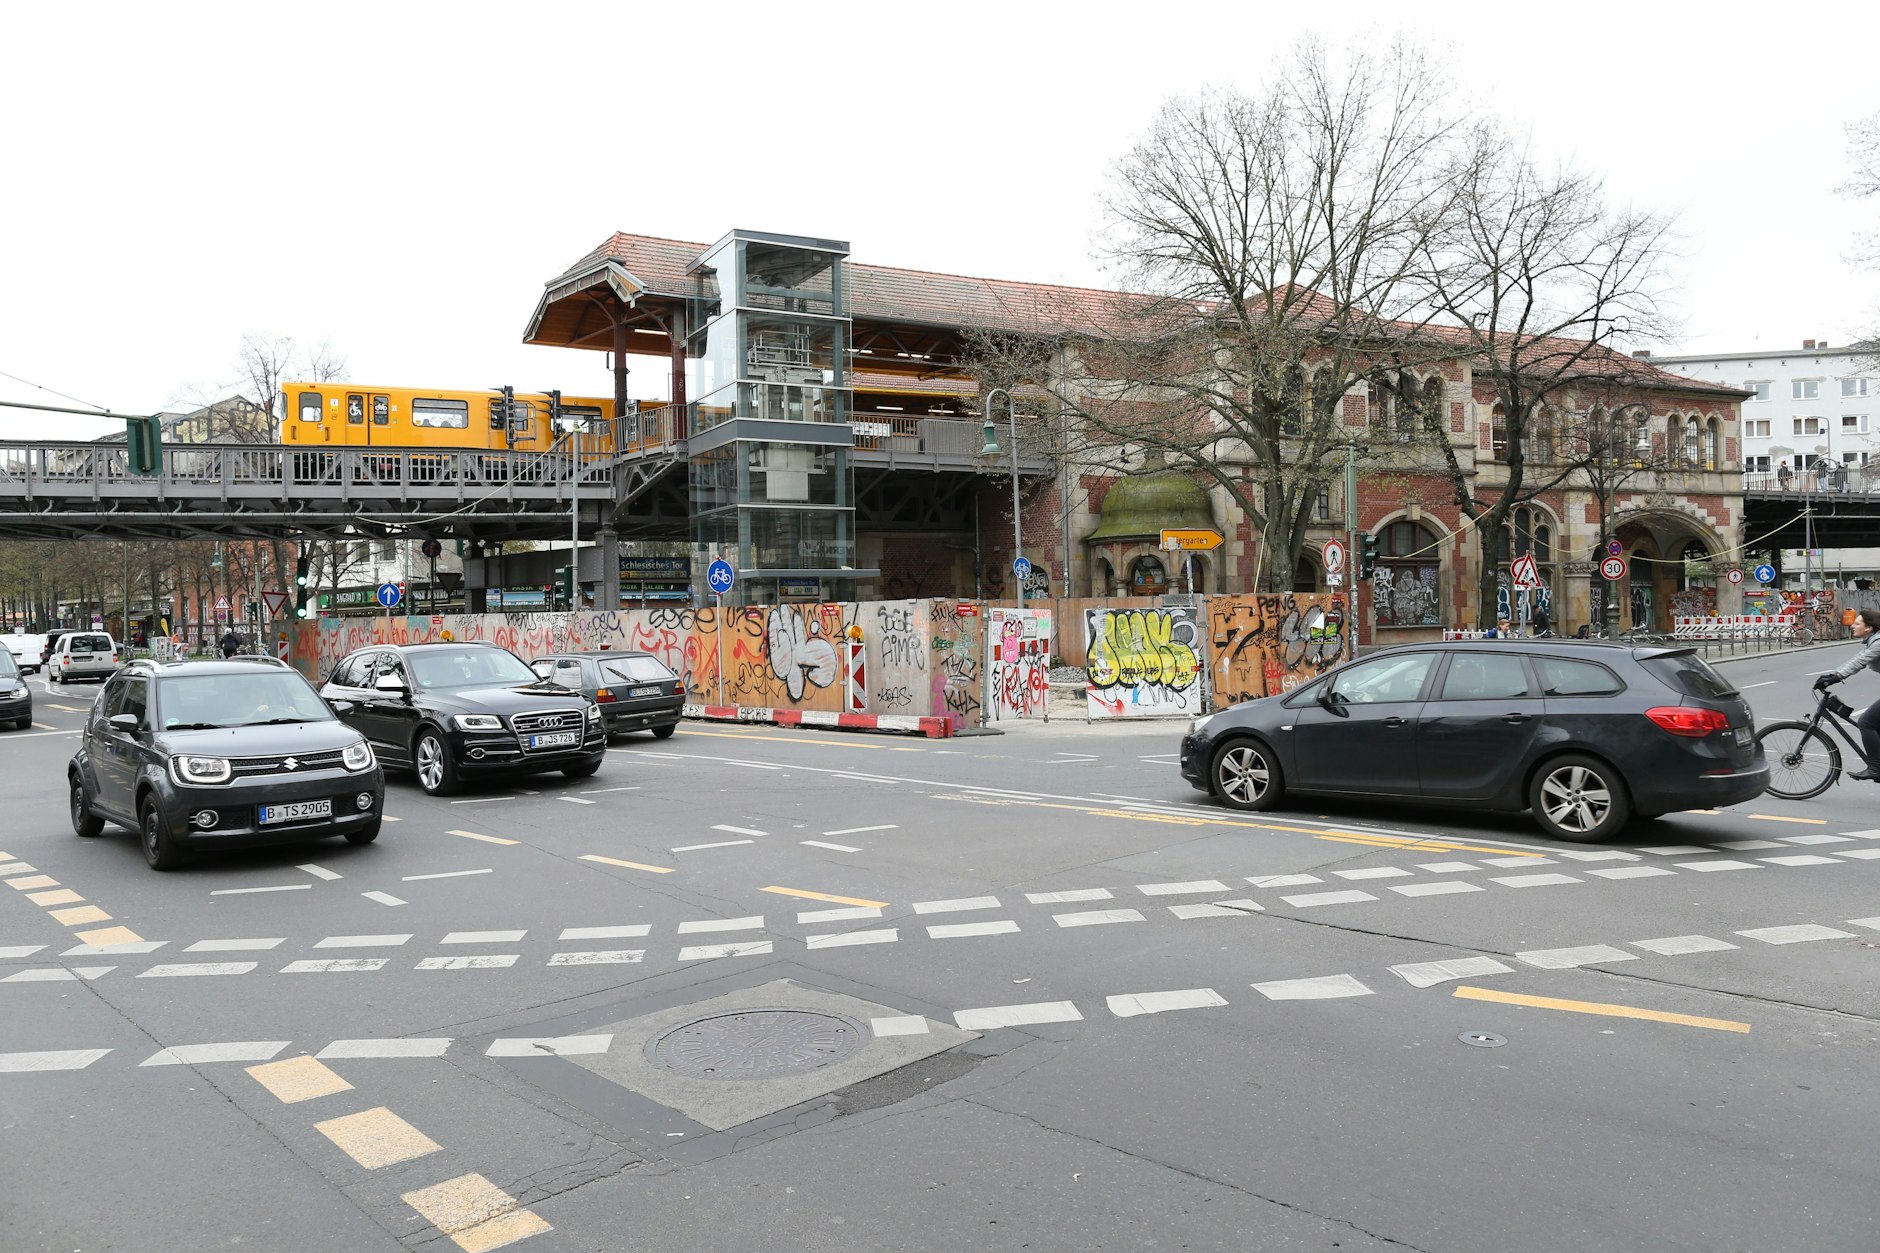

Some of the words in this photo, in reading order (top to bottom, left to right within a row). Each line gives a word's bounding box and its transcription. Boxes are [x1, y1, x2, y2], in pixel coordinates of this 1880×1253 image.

[1174, 536, 1208, 546] iergarten
[620, 560, 669, 570] Schlesisches
[672, 561, 685, 569] Tor
[1606, 563, 1621, 574] 30
[538, 736, 544, 745] B
[549, 735, 558, 744] JS
[267, 808, 275, 819] B
[283, 805, 299, 816] TS
[301, 802, 329, 815] 2905
